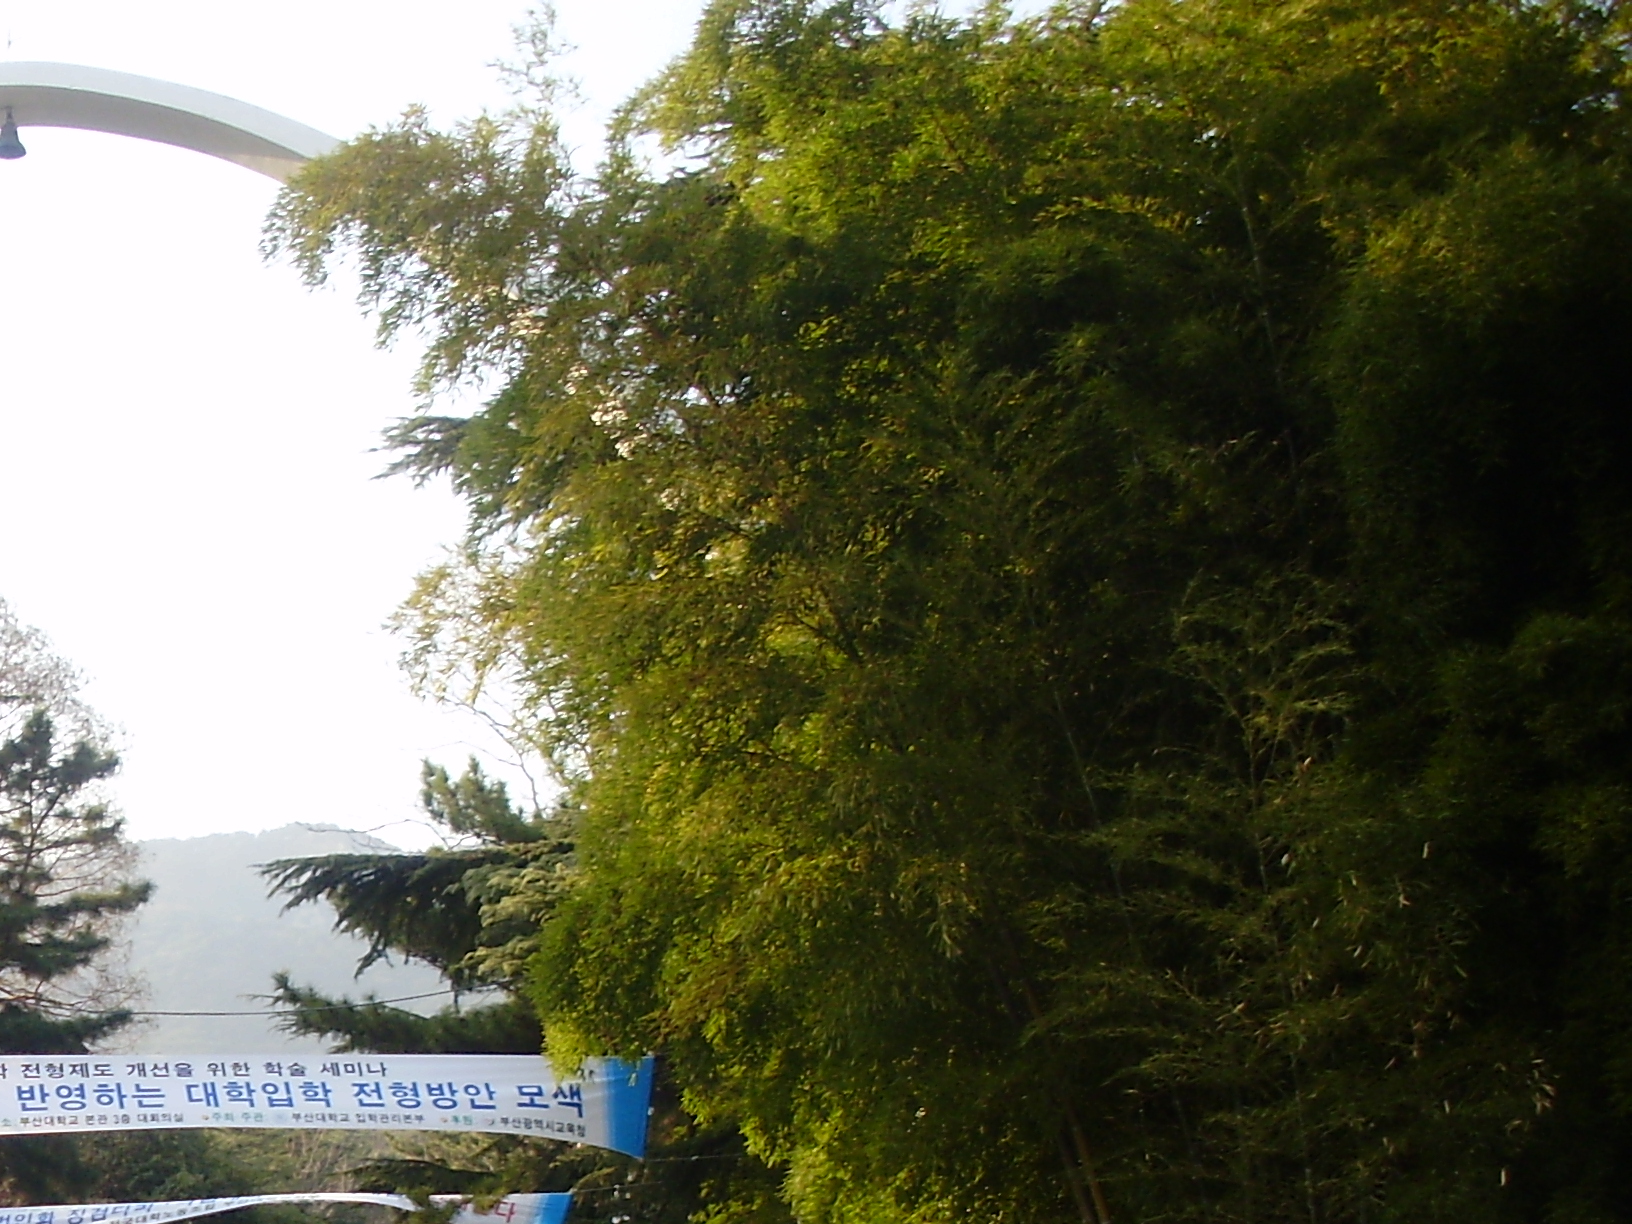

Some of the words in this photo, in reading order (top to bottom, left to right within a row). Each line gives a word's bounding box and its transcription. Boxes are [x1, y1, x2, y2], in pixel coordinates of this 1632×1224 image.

[21, 1062, 115, 1079] 전형제도
[126, 1062, 195, 1078] 개선을
[207, 1061, 251, 1077] 위한
[263, 1061, 308, 1077] 학술
[320, 1061, 388, 1077] 세미나
[16, 1081, 166, 1112] 반영하는
[185, 1080, 333, 1108] 대학입학
[352, 1080, 497, 1110] 전형방안
[516, 1083, 584, 1118] 모색
[19, 1113, 79, 1128] 부산대학교
[292, 1112, 351, 1124] 부산대학교
